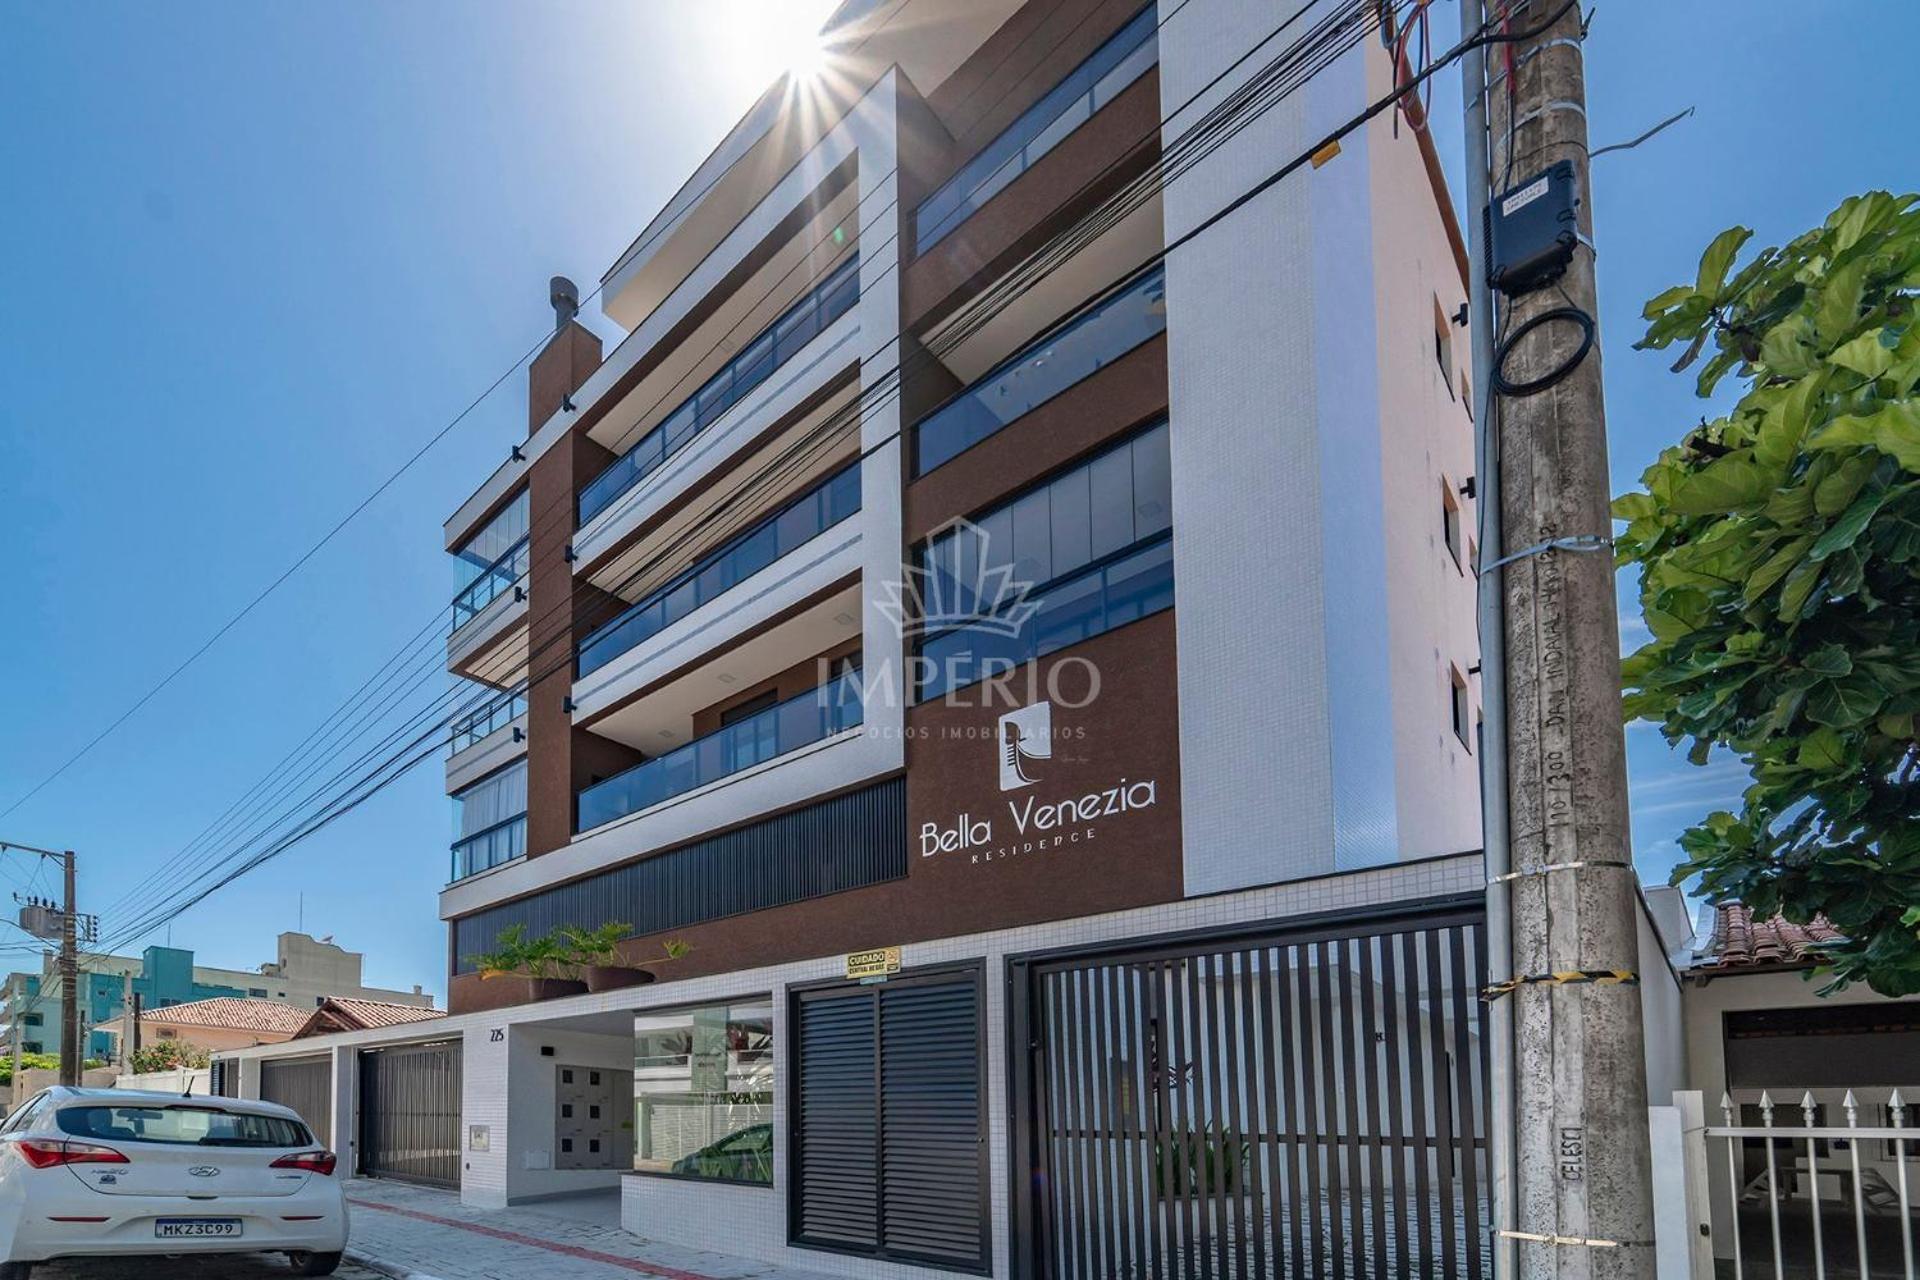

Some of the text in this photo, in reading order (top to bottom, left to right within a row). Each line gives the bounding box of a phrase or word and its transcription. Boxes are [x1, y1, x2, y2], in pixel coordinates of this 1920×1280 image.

[919, 777, 1156, 858] Bella Venezia
[971, 828, 1097, 864] RESIDENCE
[849, 952, 885, 965] CUIDADO
[490, 1027, 504, 1042] 225
[163, 1224, 234, 1236] MKZ3C99
